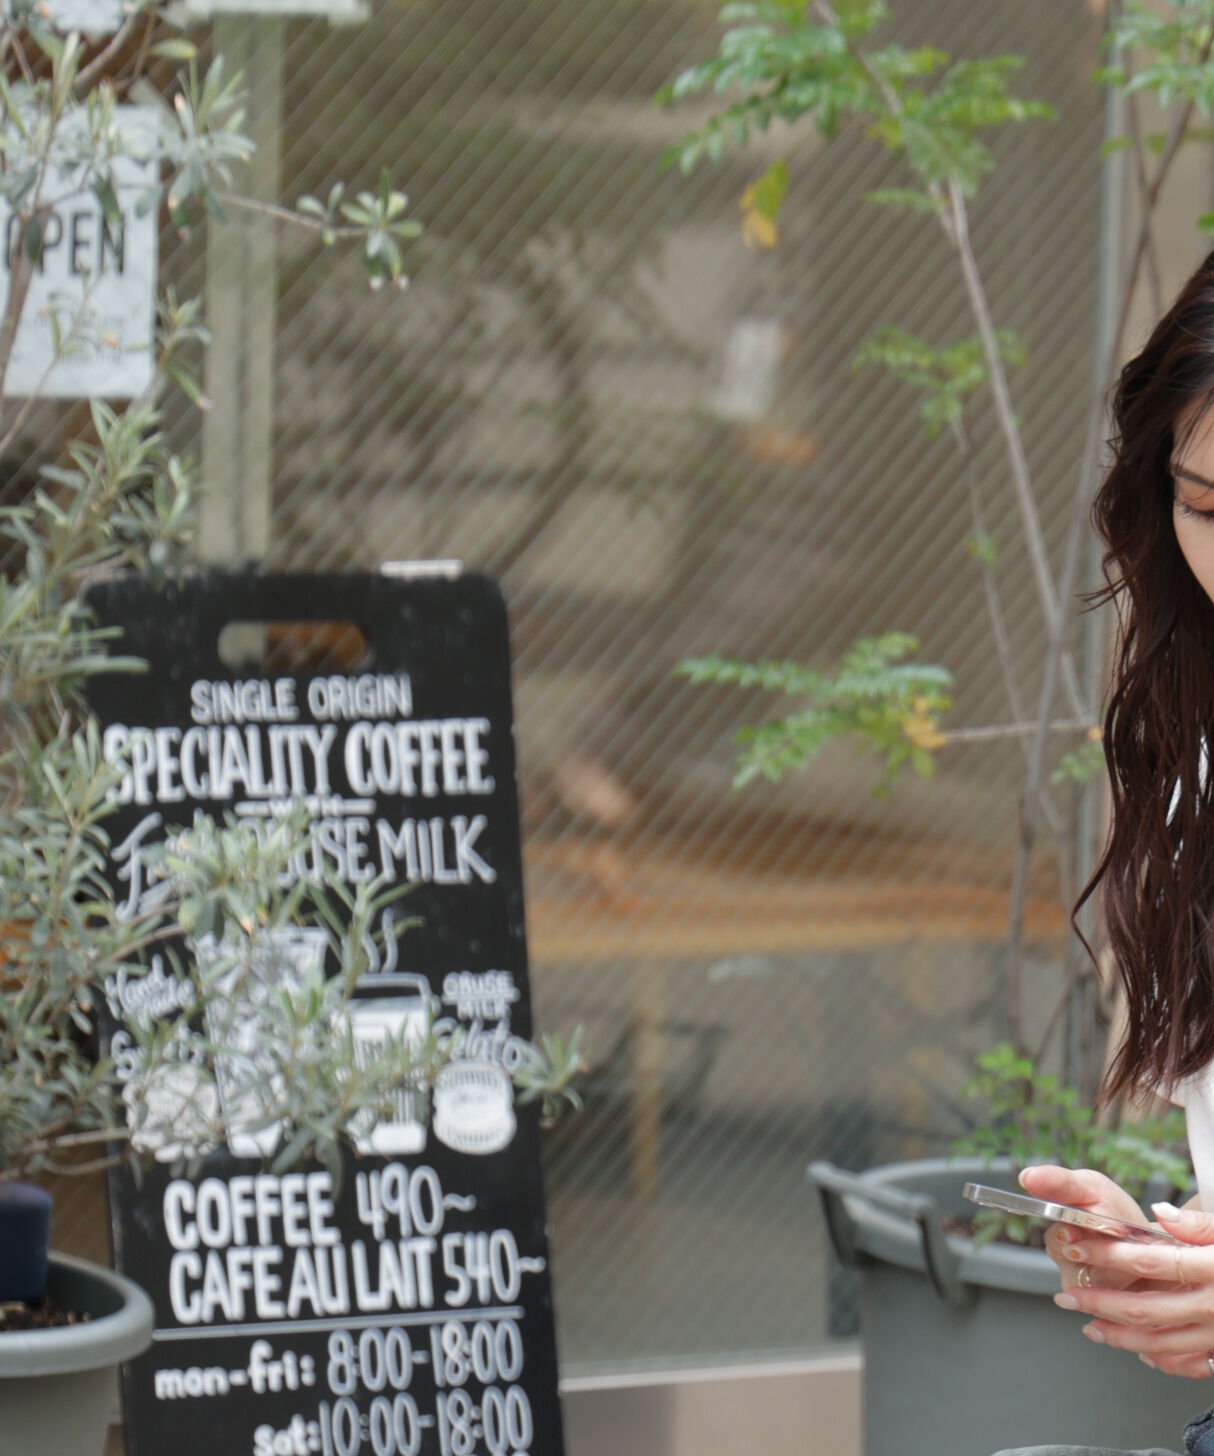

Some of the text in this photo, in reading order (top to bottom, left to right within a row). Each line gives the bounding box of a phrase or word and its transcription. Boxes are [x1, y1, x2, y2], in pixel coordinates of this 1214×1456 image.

[190, 673, 412, 724] SINGLE ORIGIN
[103, 717, 495, 804] SPECIALITY COFFEE
[376, 814, 497, 884] MILK
[163, 1171, 340, 1251] COFFEE
[169, 1245, 286, 1324] CAFE
[287, 1243, 350, 1318] AU
[351, 1236, 437, 1312] LAIT
[327, 1318, 524, 1396] 8:00-18:00
